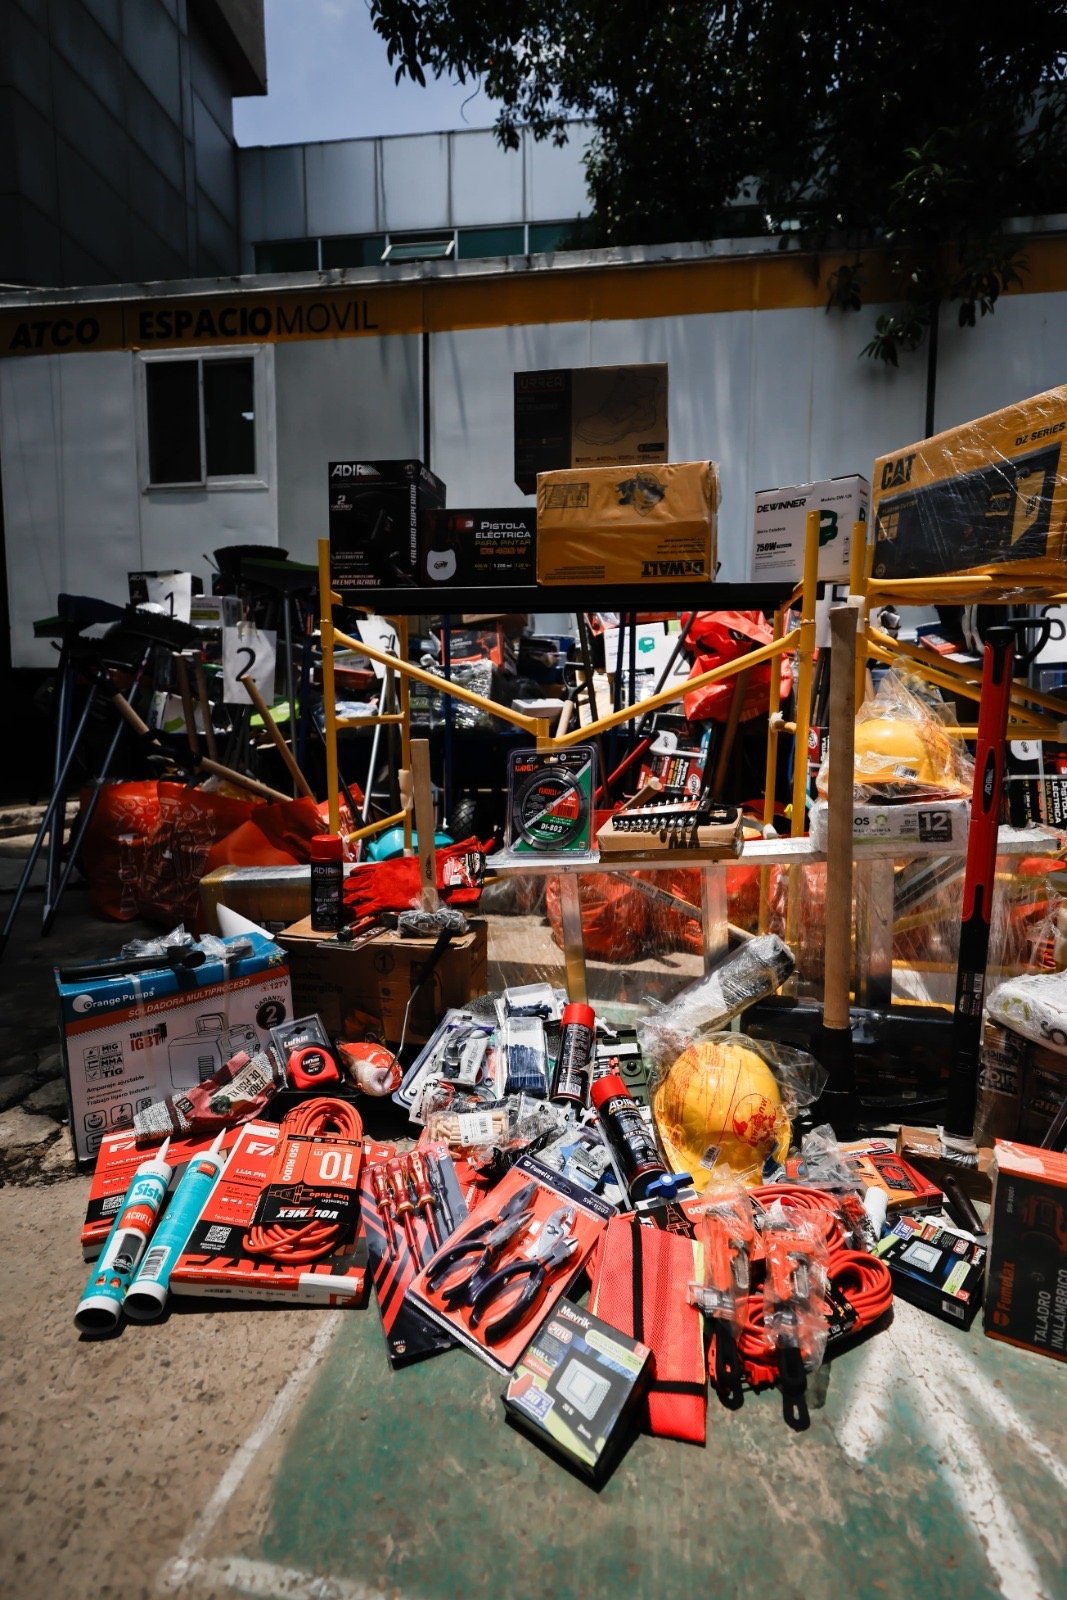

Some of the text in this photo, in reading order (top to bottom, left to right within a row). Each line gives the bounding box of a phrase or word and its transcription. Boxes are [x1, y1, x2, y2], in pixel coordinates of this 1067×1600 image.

[9, 317, 100, 350] ATCO
[1015, 422, 1066, 446] DZ SERIES
[881, 453, 918, 490] CAT
[756, 498, 806, 513] DEWINNER
[475, 530, 531, 539] ELÉCTRICA
[481, 521, 526, 530] PISTOLA
[756, 542, 777, 552] 750W
[164, 591, 177, 617] 1
[235, 647, 256, 683] 2
[541, 823, 563, 833] DI-802
[922, 812, 948, 831] 12
[269, 980, 288, 991] 127V
[122, 989, 155, 1002] Pumps
[128, 978, 250, 1017] SOLDADORA MULTIPROCESO
[265, 1005, 277, 1023] 2
[102, 1043, 119, 1052] MIG
[130, 1034, 160, 1052] IGBT
[283, 1035, 309, 1048] Lufkin
[101, 1056, 123, 1067] MMA
[102, 1067, 123, 1078] TIG
[282, 1143, 300, 1182] USO RUDO
[319, 1151, 354, 1182] 10
[333, 1193, 350, 1201] Uso
[275, 1206, 339, 1220] VOLTMEX
[560, 1305, 591, 1330] Mavrik
[1033, 1290, 1052, 1344] TALADRO
[1050, 1269, 1067, 1349] INALÁMBRICO
